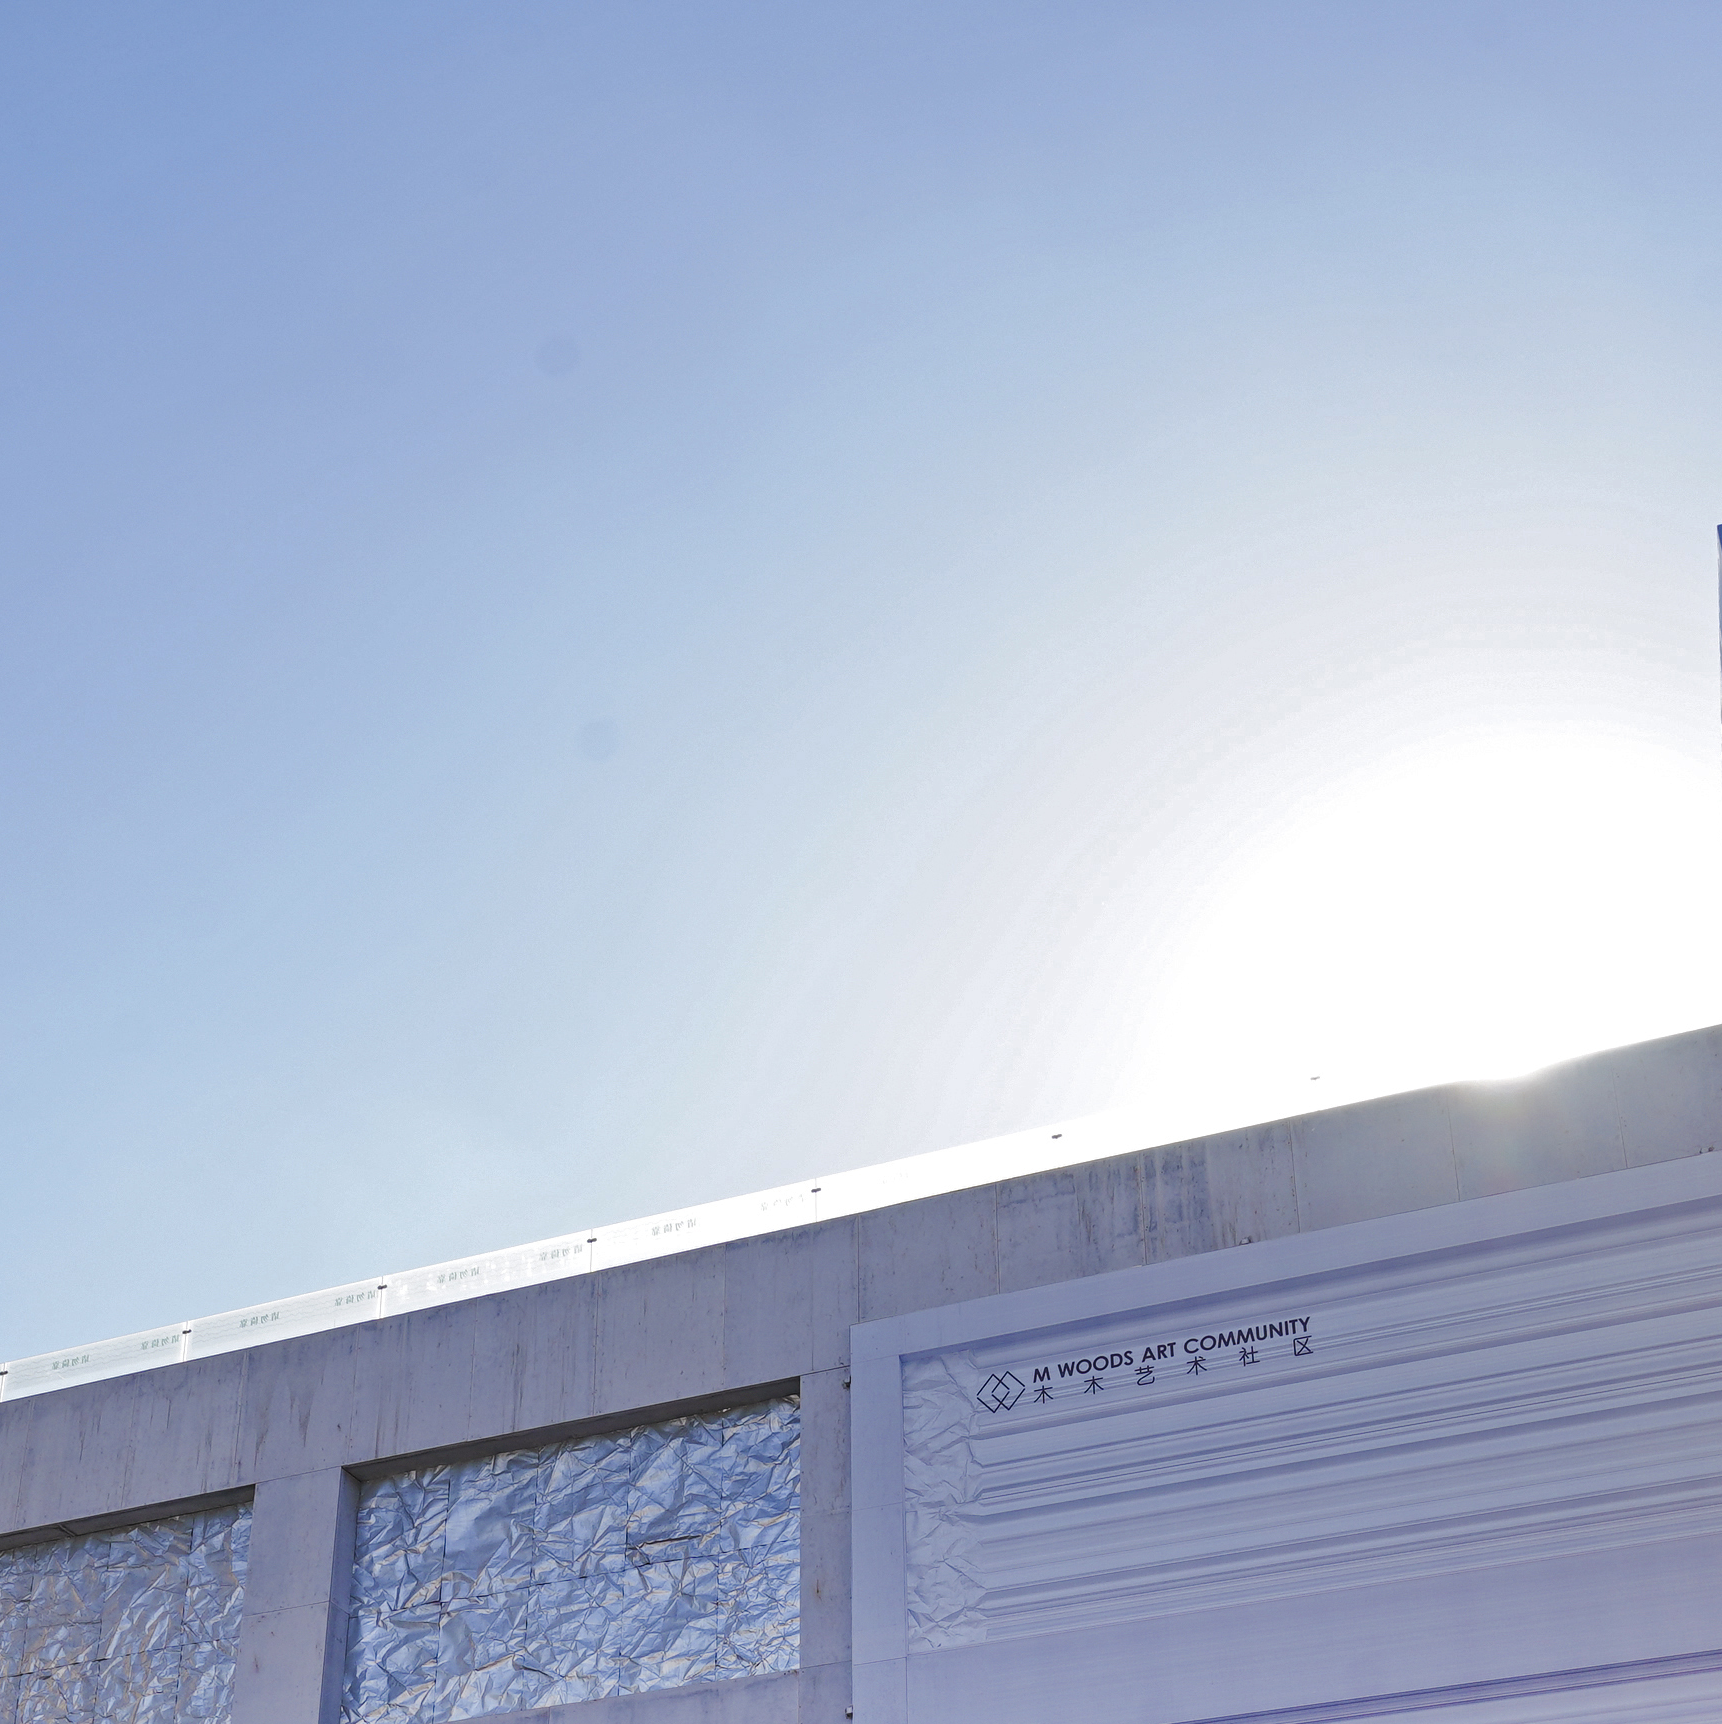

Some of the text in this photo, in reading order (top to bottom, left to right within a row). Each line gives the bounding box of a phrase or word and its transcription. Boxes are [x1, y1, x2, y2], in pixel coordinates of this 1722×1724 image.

[1032, 1316, 1311, 1383] M WOODS ART COMMUNITY
[1033, 1335, 1314, 1404] 木木艺术社区
